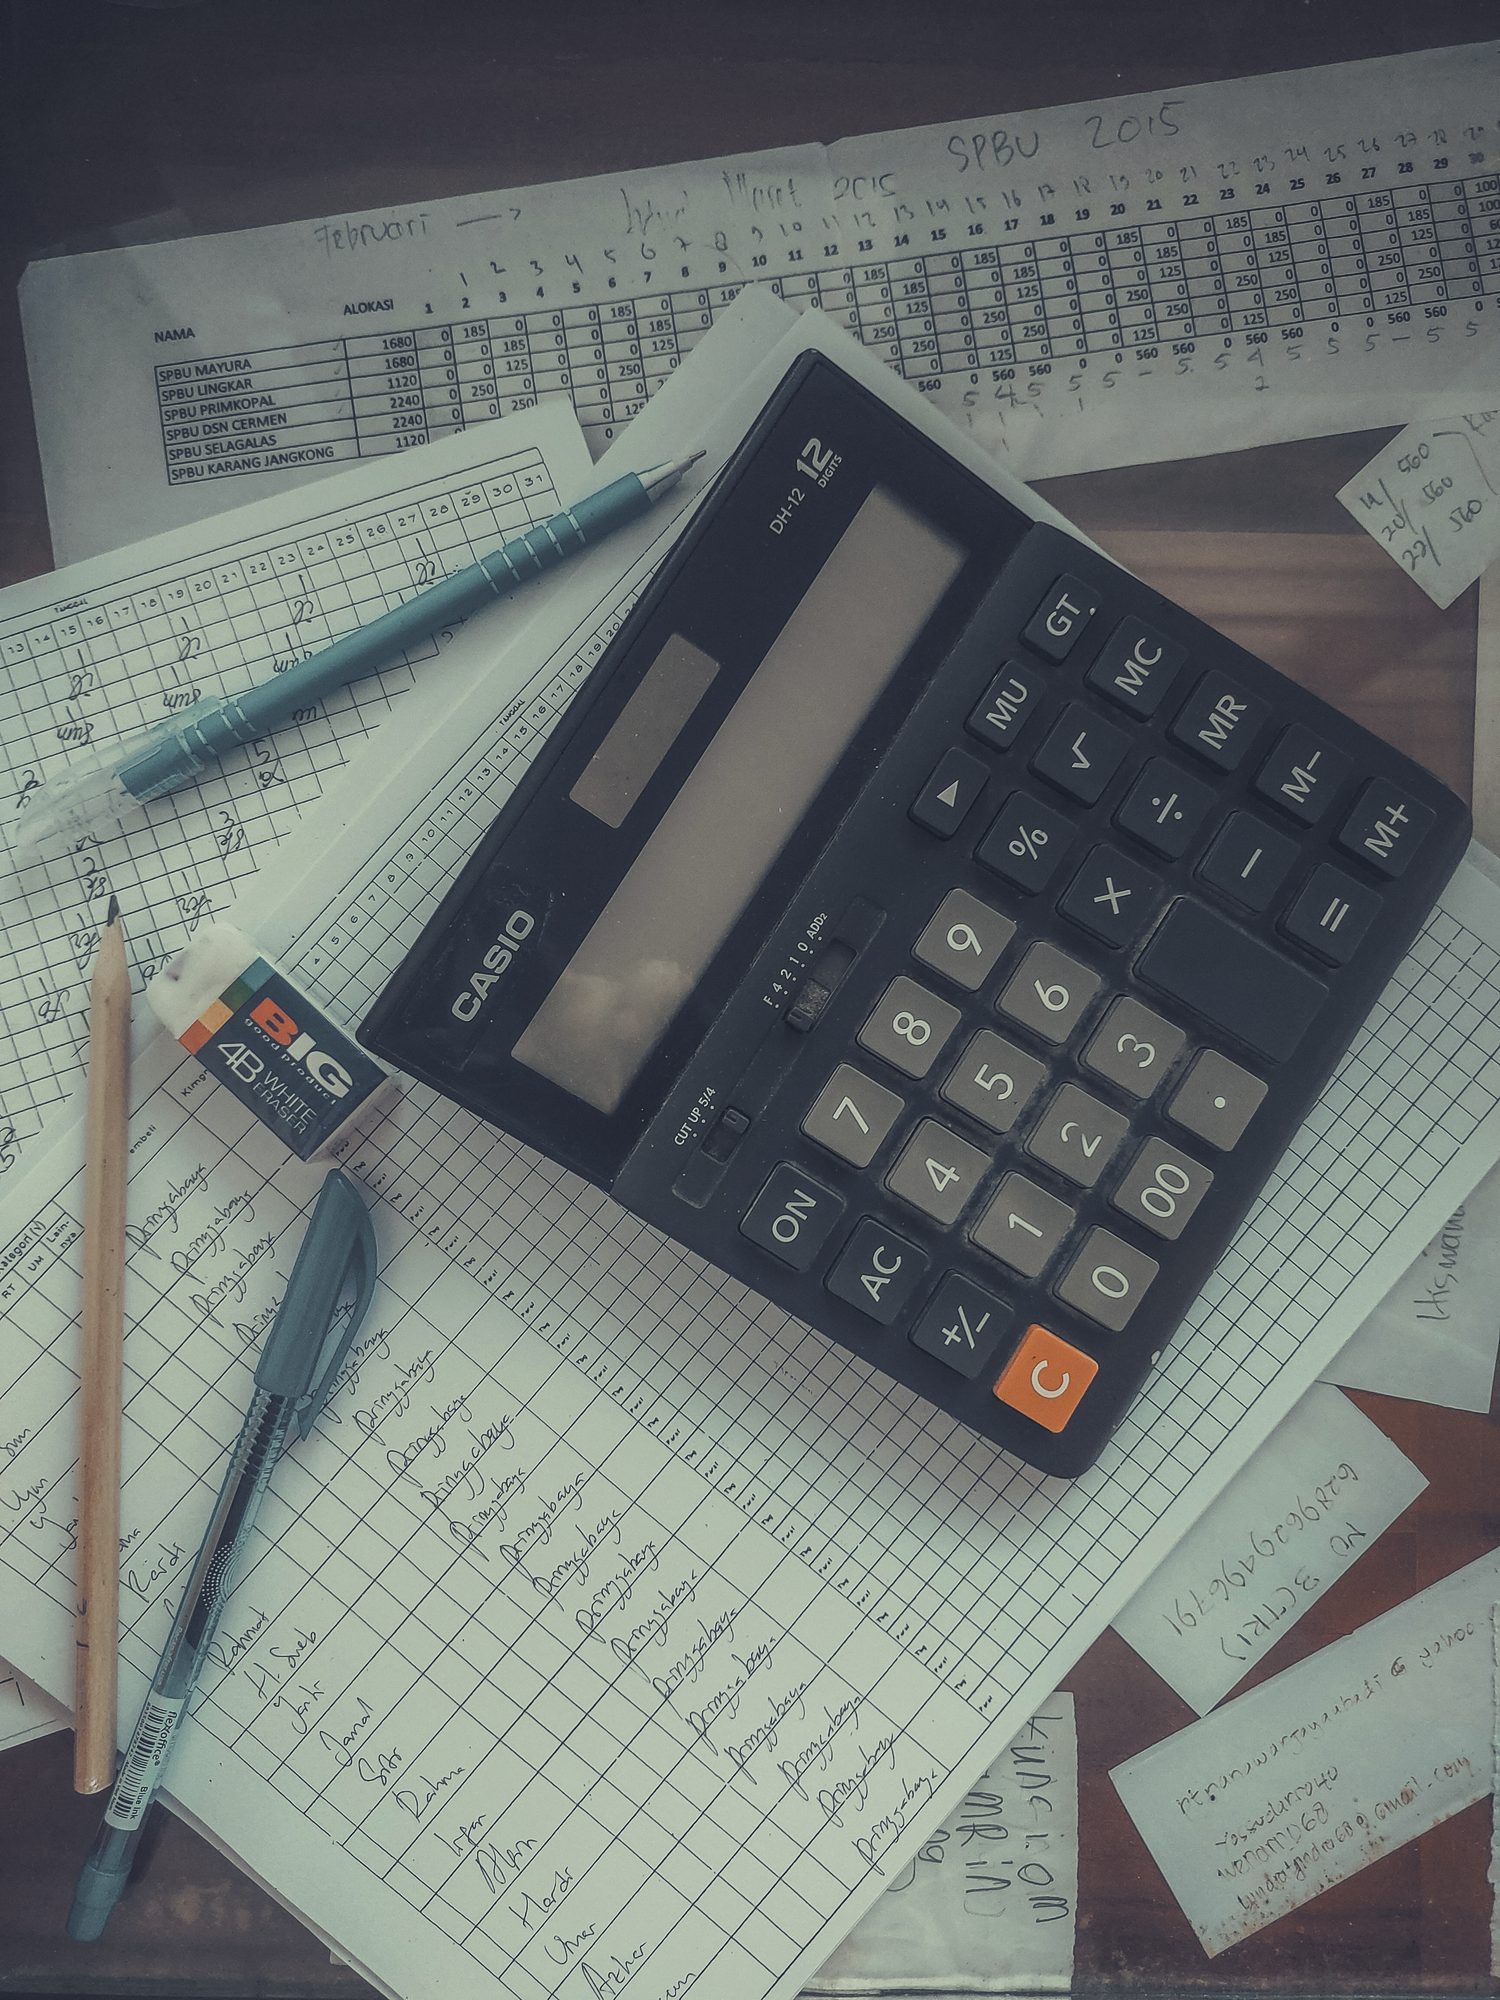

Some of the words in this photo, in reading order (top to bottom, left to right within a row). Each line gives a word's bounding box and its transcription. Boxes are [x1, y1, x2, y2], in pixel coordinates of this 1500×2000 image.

[948, 131, 1041, 173] SPBU
[1083, 103, 1184, 149] 2015
[342, 298, 395, 316] ALOKASI
[424, 303, 435, 315] 1
[461, 297, 472, 309] 2
[535, 286, 546, 298] 4
[571, 281, 582, 293] 5
[607, 276, 617, 289] 6
[642, 271, 652, 284] 7
[717, 261, 727, 273] 9
[751, 254, 768, 268] 10
[788, 249, 804, 262] 11
[857, 239, 874, 252] 13
[929, 229, 947, 242] 15
[967, 223, 984, 236] 16
[1003, 218, 1020, 231] 17
[1074, 208, 1091, 221] 19
[1109, 203, 1127, 216] 20
[1218, 188, 1236, 201] 23
[1253, 182, 1271, 195] 24
[1288, 177, 1306, 190] 25
[1324, 172, 1342, 185] 26
[1359, 167, 1377, 179] 27
[1396, 161, 1414, 174] 28
[1431, 157, 1449, 170] 29
[153, 326, 196, 344] NAMA
[157, 365, 193, 382] SPBU
[193, 358, 253, 378] MAYURA
[381, 335, 413, 350] 1680
[1028, 362, 1052, 378] 560
[1135, 346, 1160, 362] 560
[1244, 331, 1269, 346] 560
[1386, 310, 1411, 326] 560
[1423, 304, 1448, 319] 560
[160, 384, 195, 402] SPBU
[196, 377, 254, 398] LINGKAR
[383, 355, 416, 370] 1680
[162, 404, 198, 422] SPBU
[198, 393, 277, 418] PRIMKOPAL
[386, 374, 419, 390] 1120
[165, 424, 201, 443] SPBU
[201, 419, 229, 437] DSN
[229, 411, 288, 433] CERMEN
[389, 394, 421, 410] 2240
[167, 443, 203, 462] SPBU
[203, 433, 278, 456] SELAGALAS
[392, 413, 424, 430] 2240
[170, 463, 206, 482] SPBU
[206, 455, 258, 477] KARANG
[257, 445, 335, 469] JANGKONG
[394, 433, 426, 449] 1120
[796, 436, 834, 482] 12
[817, 453, 843, 489] DIGITS
[769, 487, 805, 535] DH-12
[60, 624, 78, 637] 15
[112, 606, 131, 619] 17
[193, 579, 213, 592] 20
[221, 571, 239, 584] 21
[277, 553, 297, 566] 23
[365, 524, 387, 538] 26
[397, 513, 417, 527] 27
[491, 482, 513, 498] 30
[524, 473, 544, 488] 31
[1046, 593, 1080, 636] GT
[1114, 638, 1162, 696] MC
[985, 678, 1028, 730] MU
[1198, 694, 1247, 750] MR
[421, 828, 437, 844] 10
[458, 788, 473, 803] 12
[513, 725, 529, 741] 15
[532, 705, 548, 720] 16
[568, 663, 585, 679] 18
[604, 622, 621, 638] 20
[1008, 825, 1048, 860] %
[1364, 804, 1409, 858] M+
[947, 923, 982, 955] 9
[451, 910, 535, 1022] CASIO
[771, 980, 785, 994] 4
[780, 966, 794, 980] 2
[1034, 980, 1069, 1011] 6
[244, 1016, 282, 1055] good
[249, 996, 354, 1099] BIG
[892, 1011, 931, 1046] 8
[1117, 1033, 1155, 1068] 3
[217, 1041, 269, 1084] 4B
[974, 1064, 1014, 1100] 5
[253, 1082, 309, 1136] ERASER
[263, 1070, 319, 1123] WHITE
[672, 1121, 697, 1148] CUT
[688, 1104, 705, 1124] UP
[698, 1085, 718, 1111] 5/4
[832, 1096, 869, 1134] 7
[1061, 1122, 1102, 1158] 2
[925, 1158, 960, 1192] 4
[1140, 1163, 1190, 1218] 00
[772, 1189, 817, 1243] ON
[1008, 1213, 1043, 1238] 1
[26, 1254, 46, 1273] UM
[860, 1246, 902, 1302] AC
[1092, 1266, 1129, 1298] 0
[1, 1281, 17, 1301] RT
[1031, 1360, 1070, 1398] C
[1327, 1521, 1367, 1558] NO
